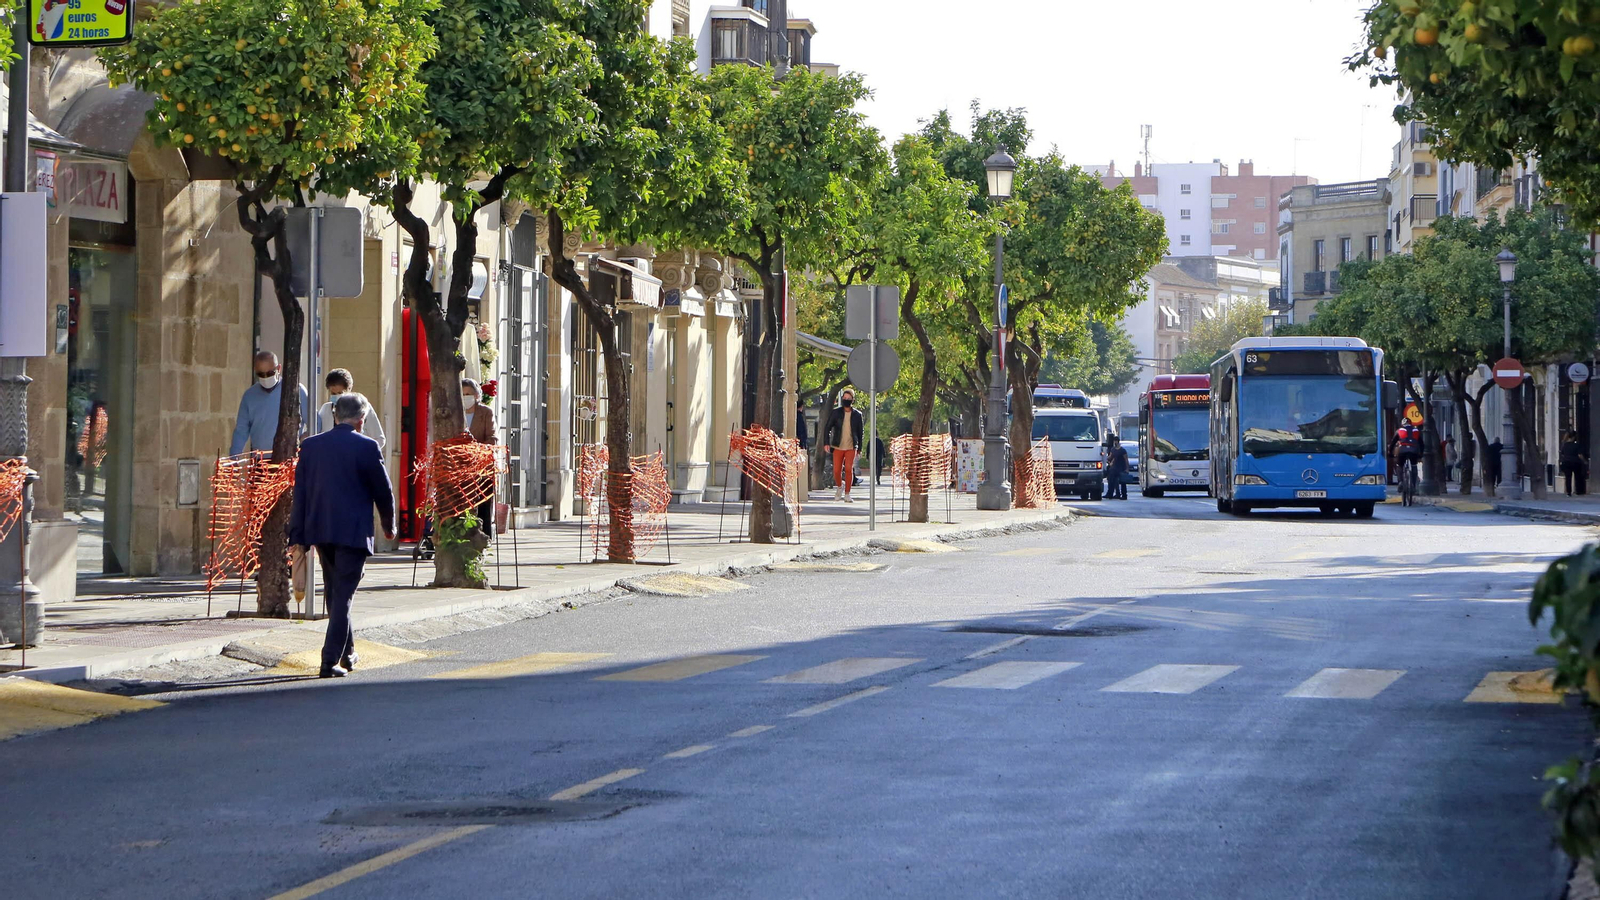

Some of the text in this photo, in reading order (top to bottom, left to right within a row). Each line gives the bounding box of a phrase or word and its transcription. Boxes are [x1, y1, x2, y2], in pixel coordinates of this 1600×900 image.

[68, 0, 81, 9] 95
[68, 13, 97, 23] euros
[68, 27, 110, 39] 24 horas
[36, 172, 55, 189] EREZ
[62, 166, 119, 211] PLAZA
[1246, 354, 1258, 363] 63
[1411, 410, 1420, 418] 10
